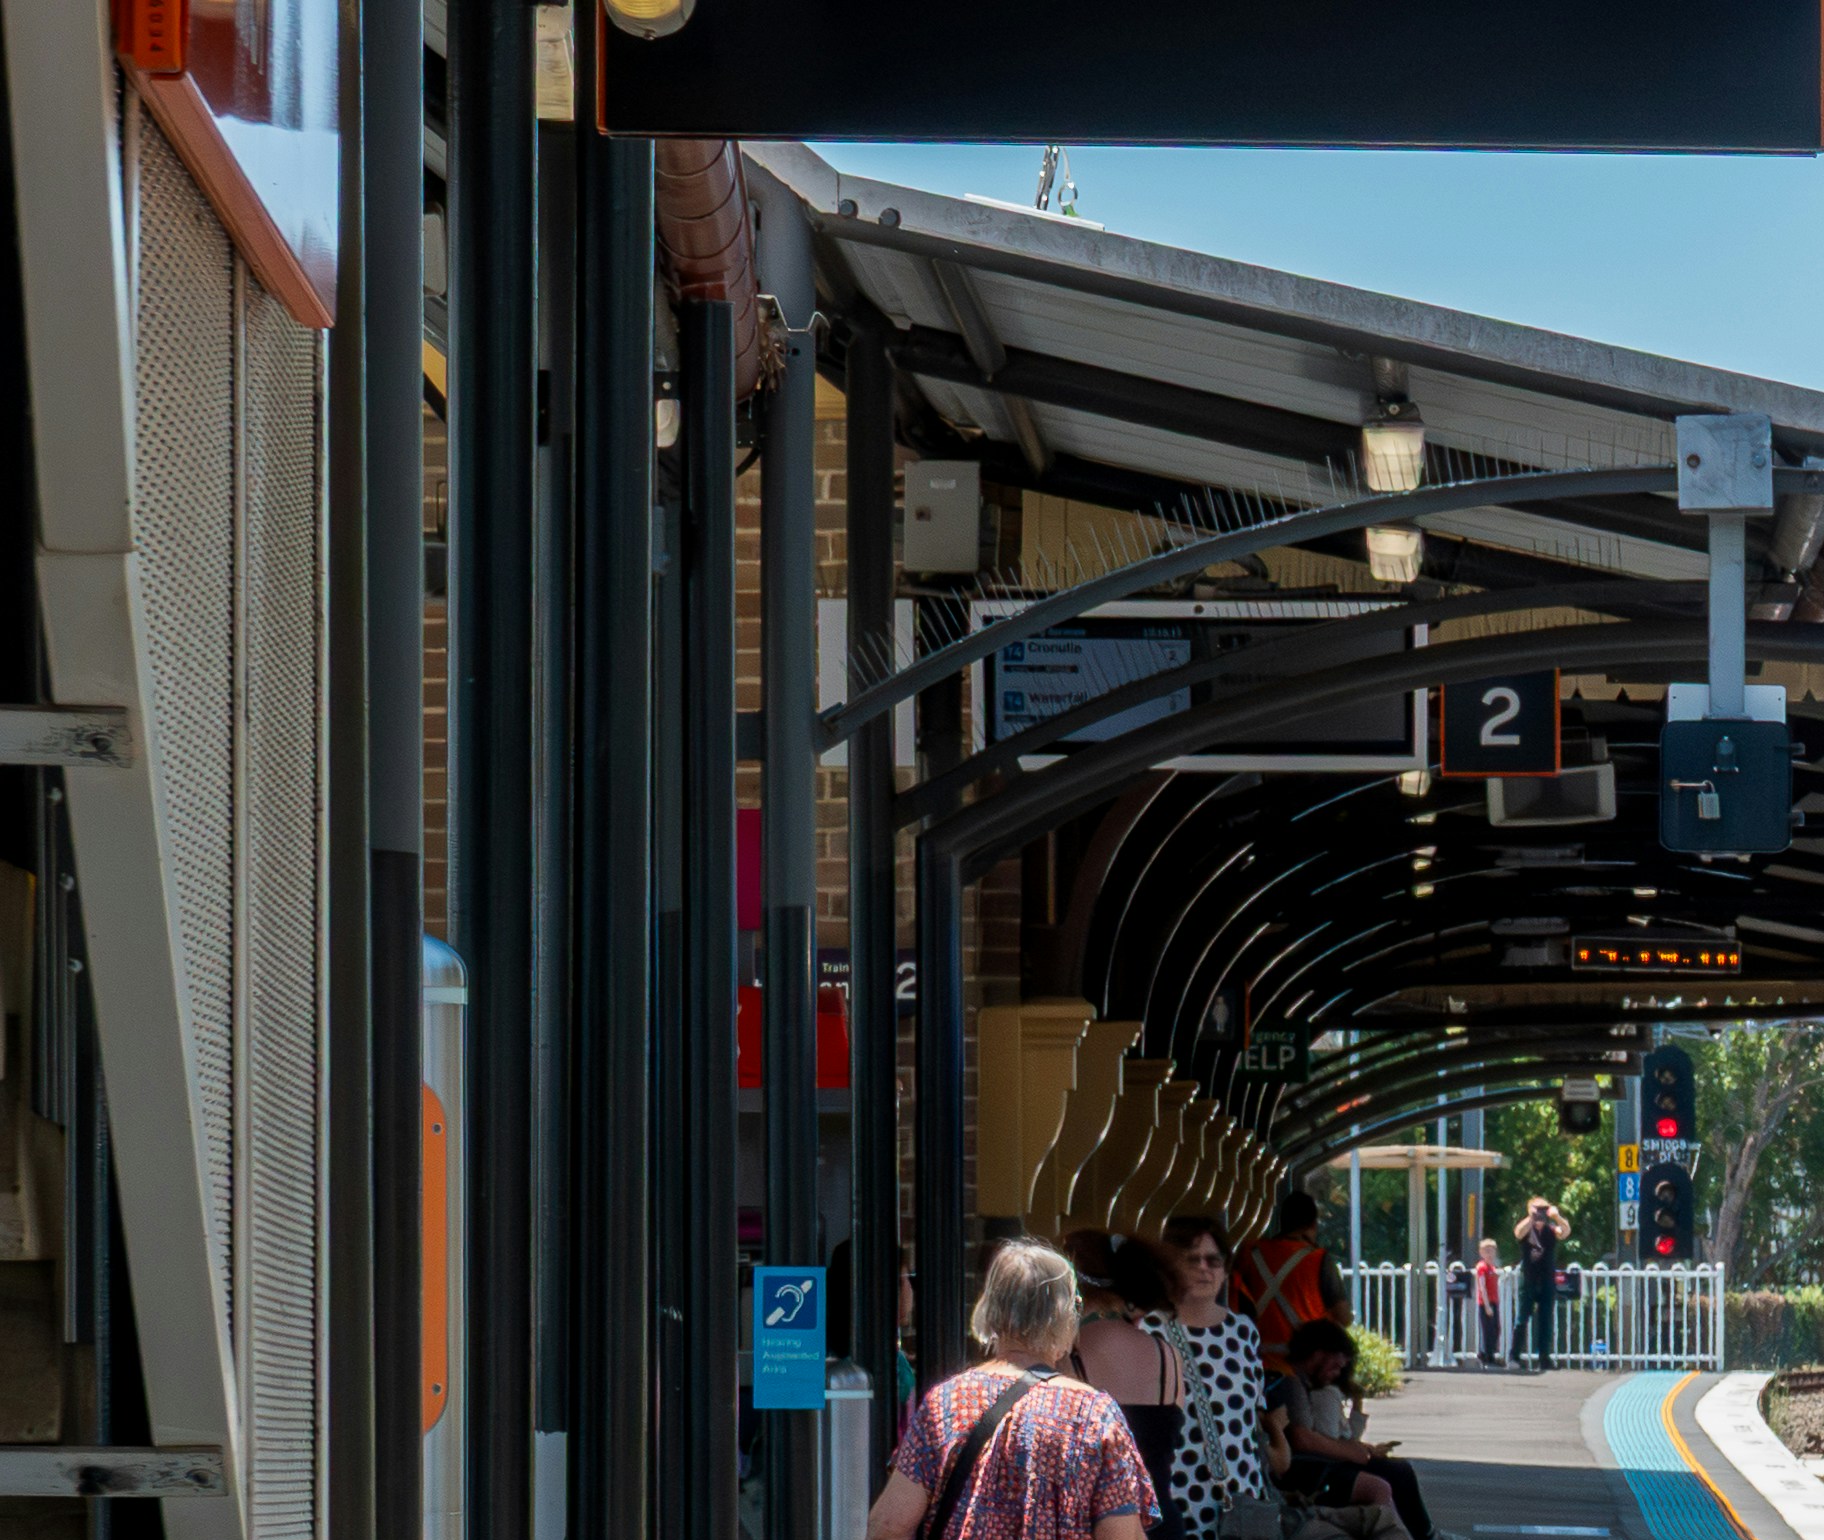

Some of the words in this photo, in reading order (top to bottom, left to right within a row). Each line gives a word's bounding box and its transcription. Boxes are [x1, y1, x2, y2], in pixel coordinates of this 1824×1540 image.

[1481, 686, 1521, 745] 2
[1237, 1045, 1296, 1070] ELP
[1625, 1177, 1634, 1198] 8
